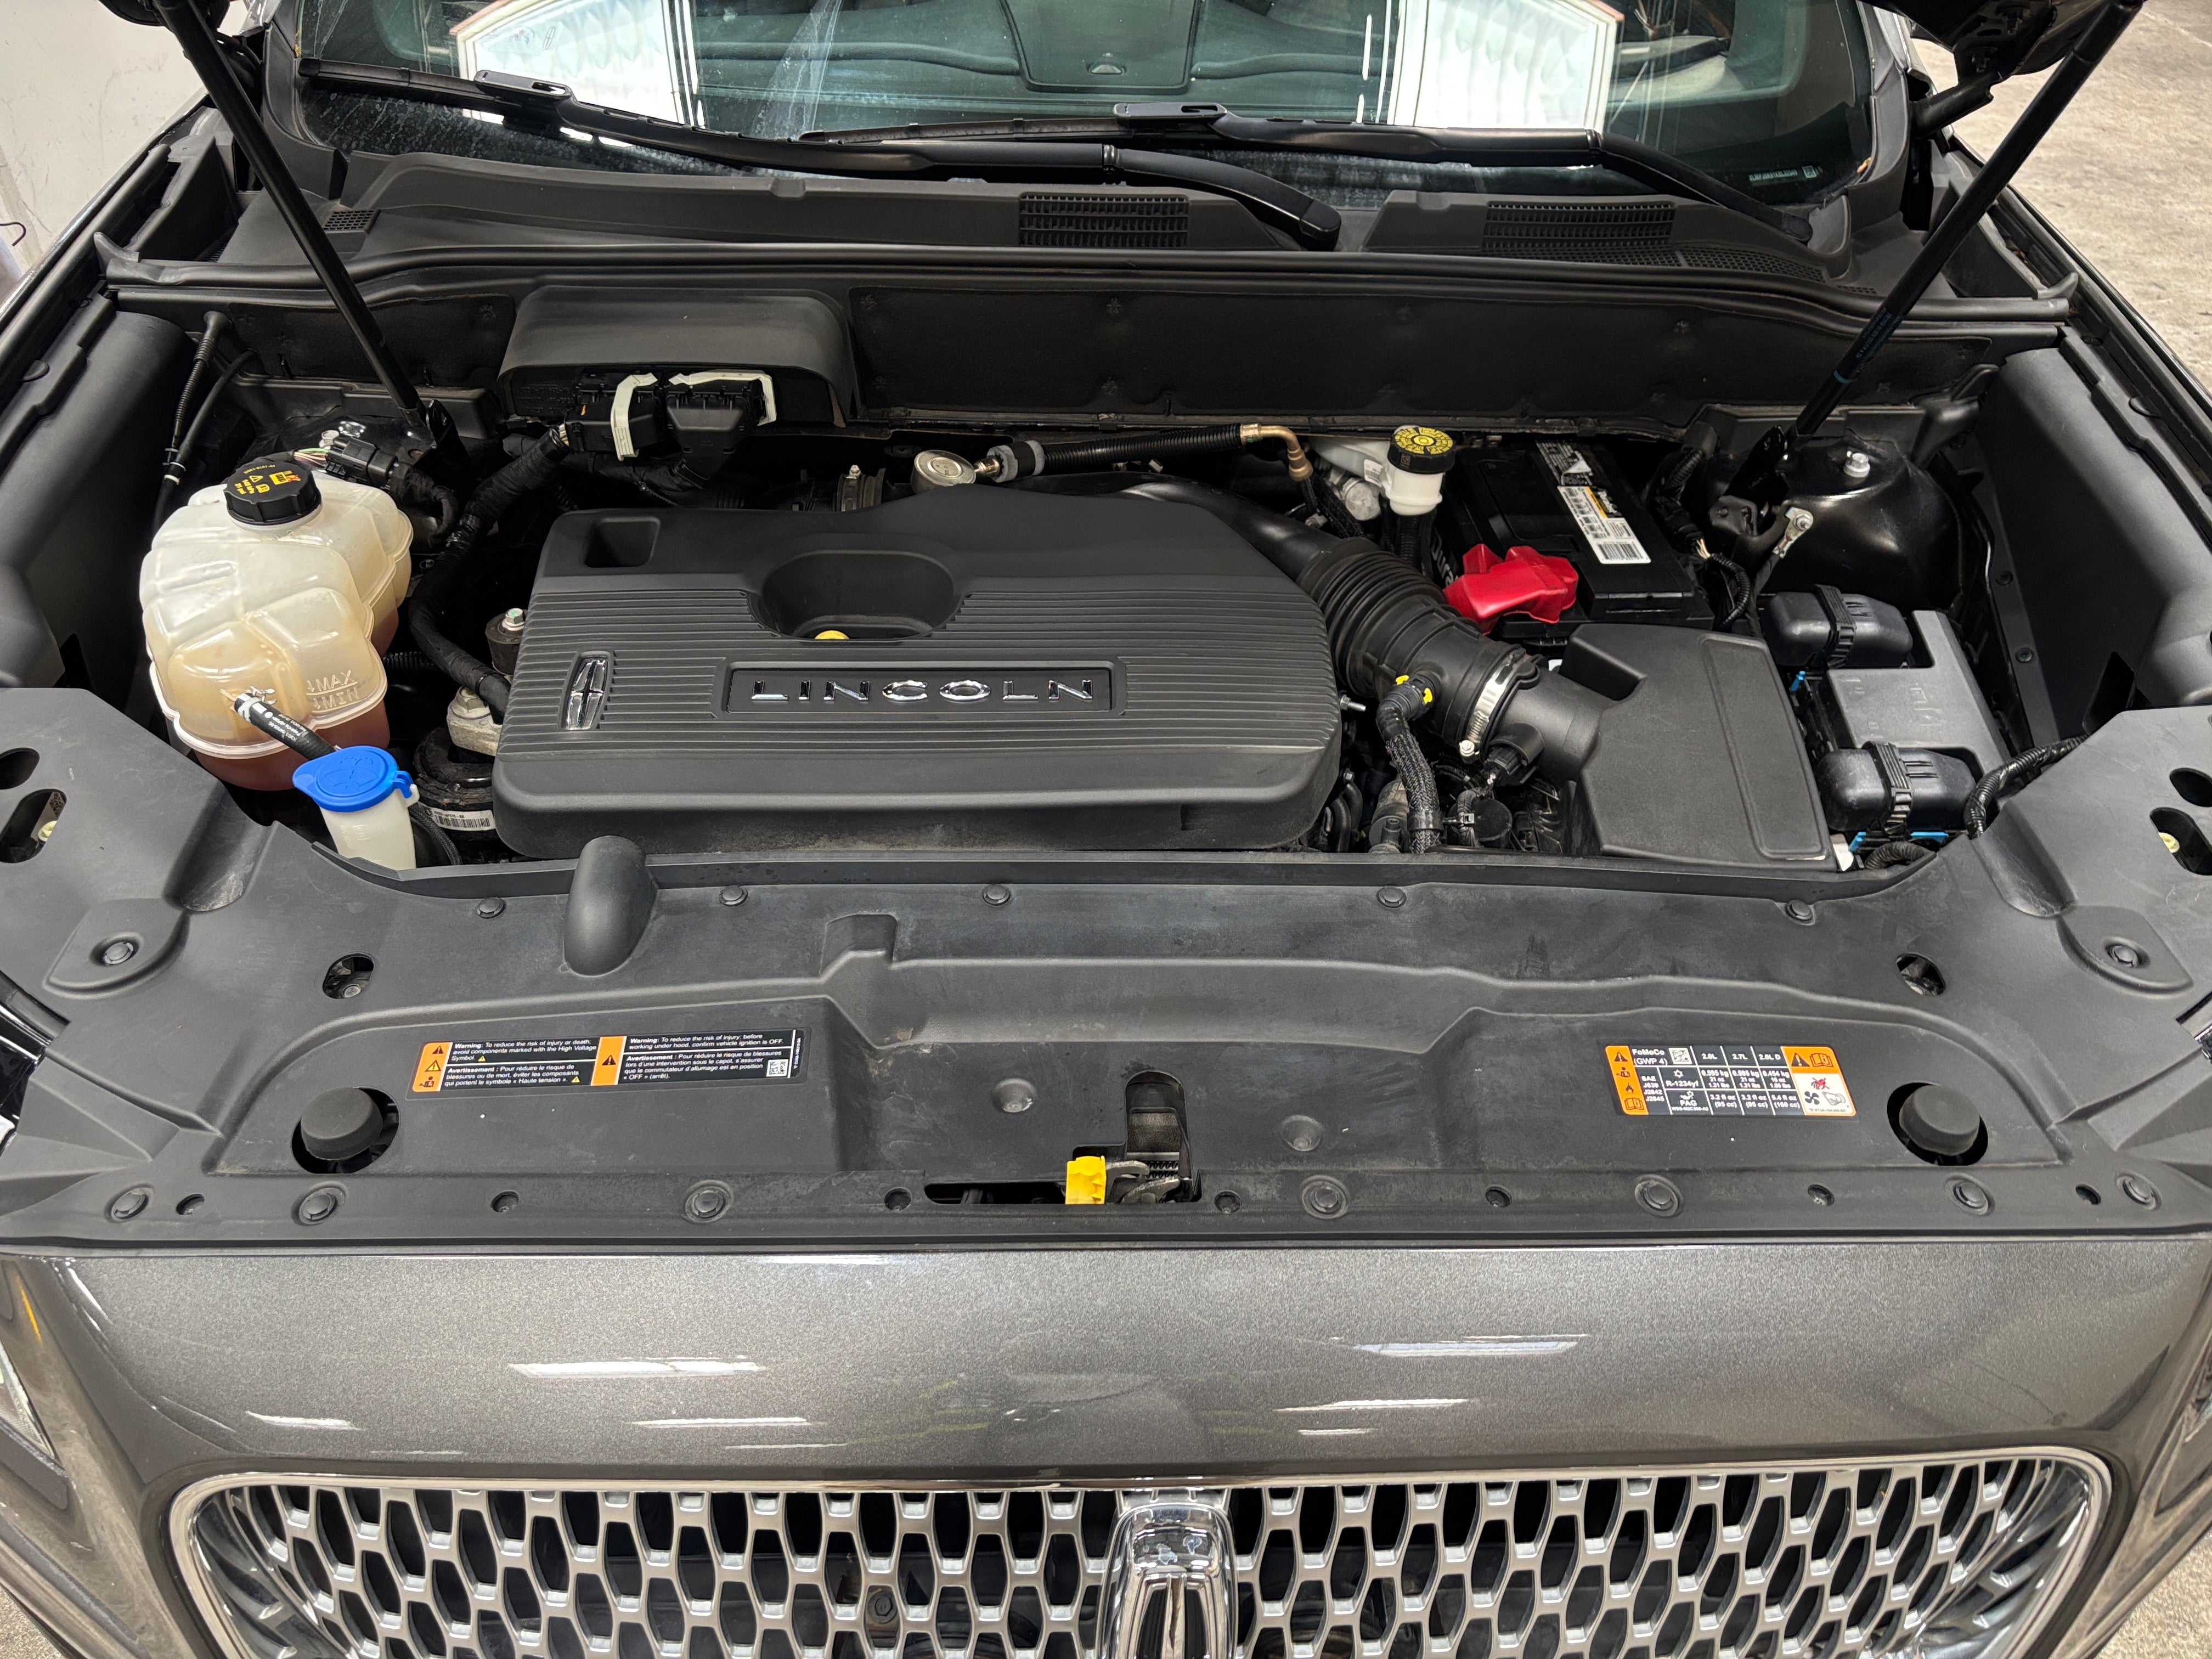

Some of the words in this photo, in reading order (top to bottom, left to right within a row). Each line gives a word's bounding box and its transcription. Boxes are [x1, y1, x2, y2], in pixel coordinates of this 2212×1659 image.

[315, 670, 354, 692] MAX
[752, 680, 1093, 702] LINCOLN
[321, 687, 359, 709] MIN
[1719, 1070, 1729, 1078] kg
[1750, 1070, 1759, 1078] kg
